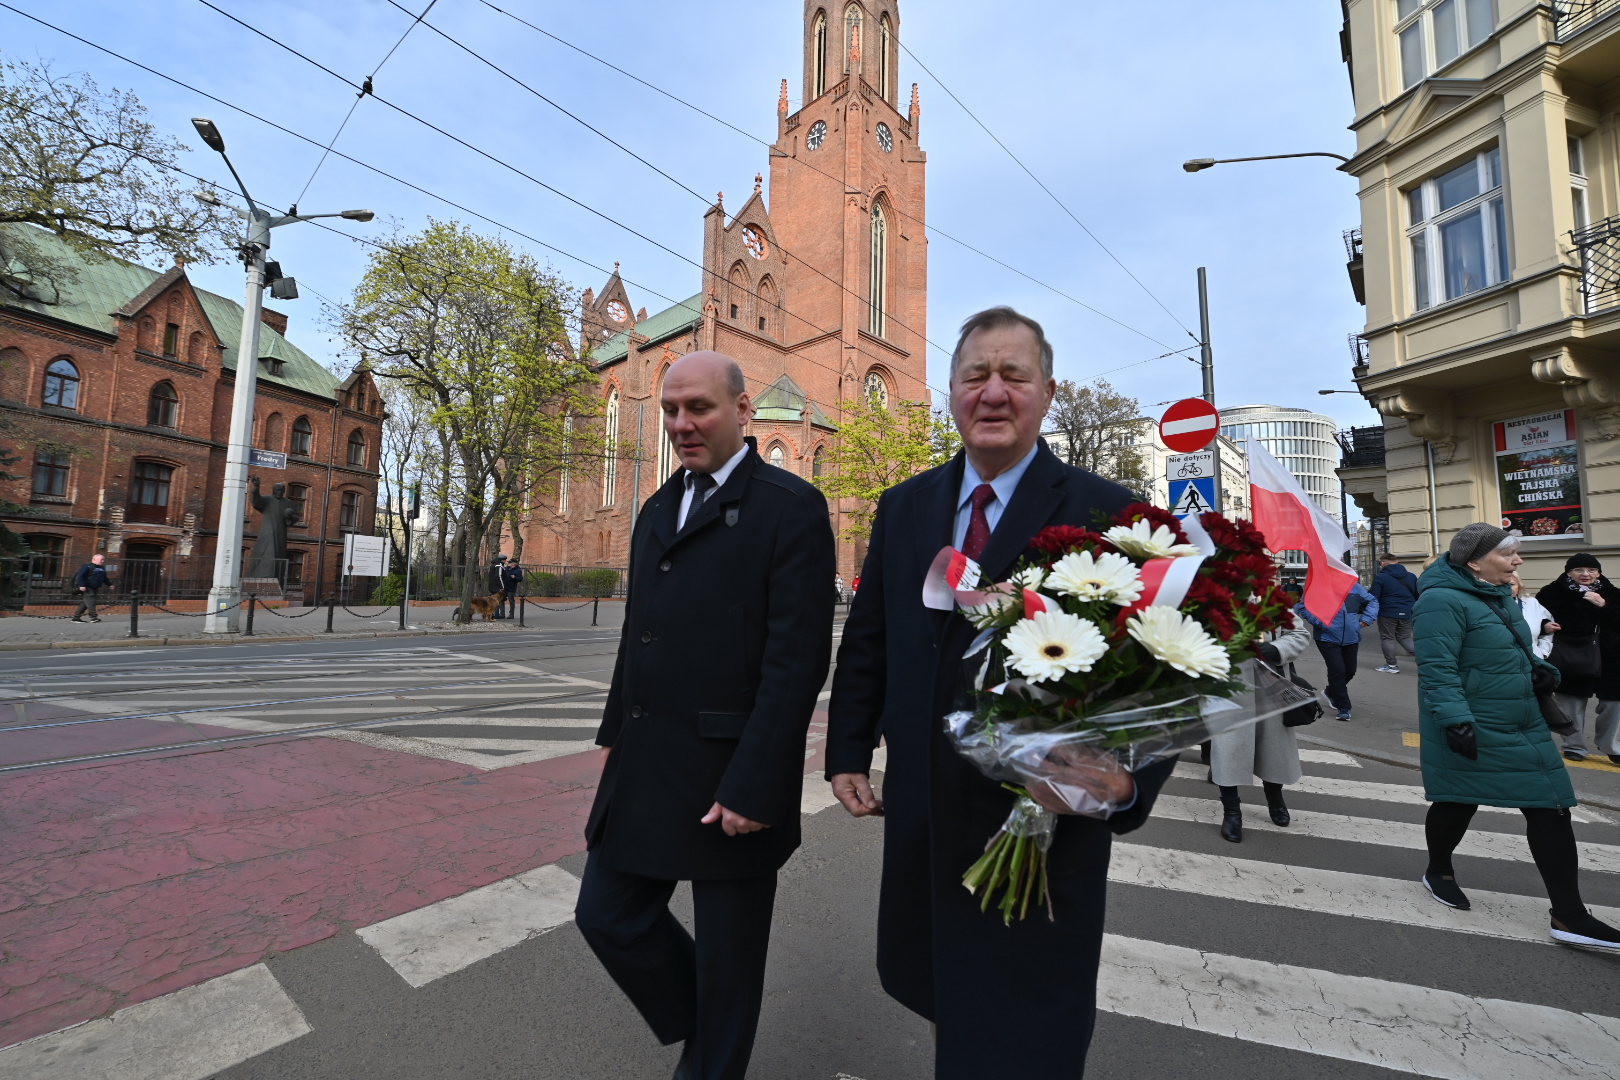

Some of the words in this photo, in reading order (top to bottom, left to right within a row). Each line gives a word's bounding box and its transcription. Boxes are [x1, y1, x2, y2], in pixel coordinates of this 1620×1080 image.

[1507, 413, 1562, 428] RESTAURACJA
[1521, 431, 1549, 441] ASIAN
[257, 455, 279, 464] Fredry
[1184, 454, 1211, 462] dotyczy
[1504, 465, 1576, 481] WIETNAMSKA
[1520, 479, 1560, 491] TAJSKA
[1518, 491, 1564, 503] CHIŃSKA
